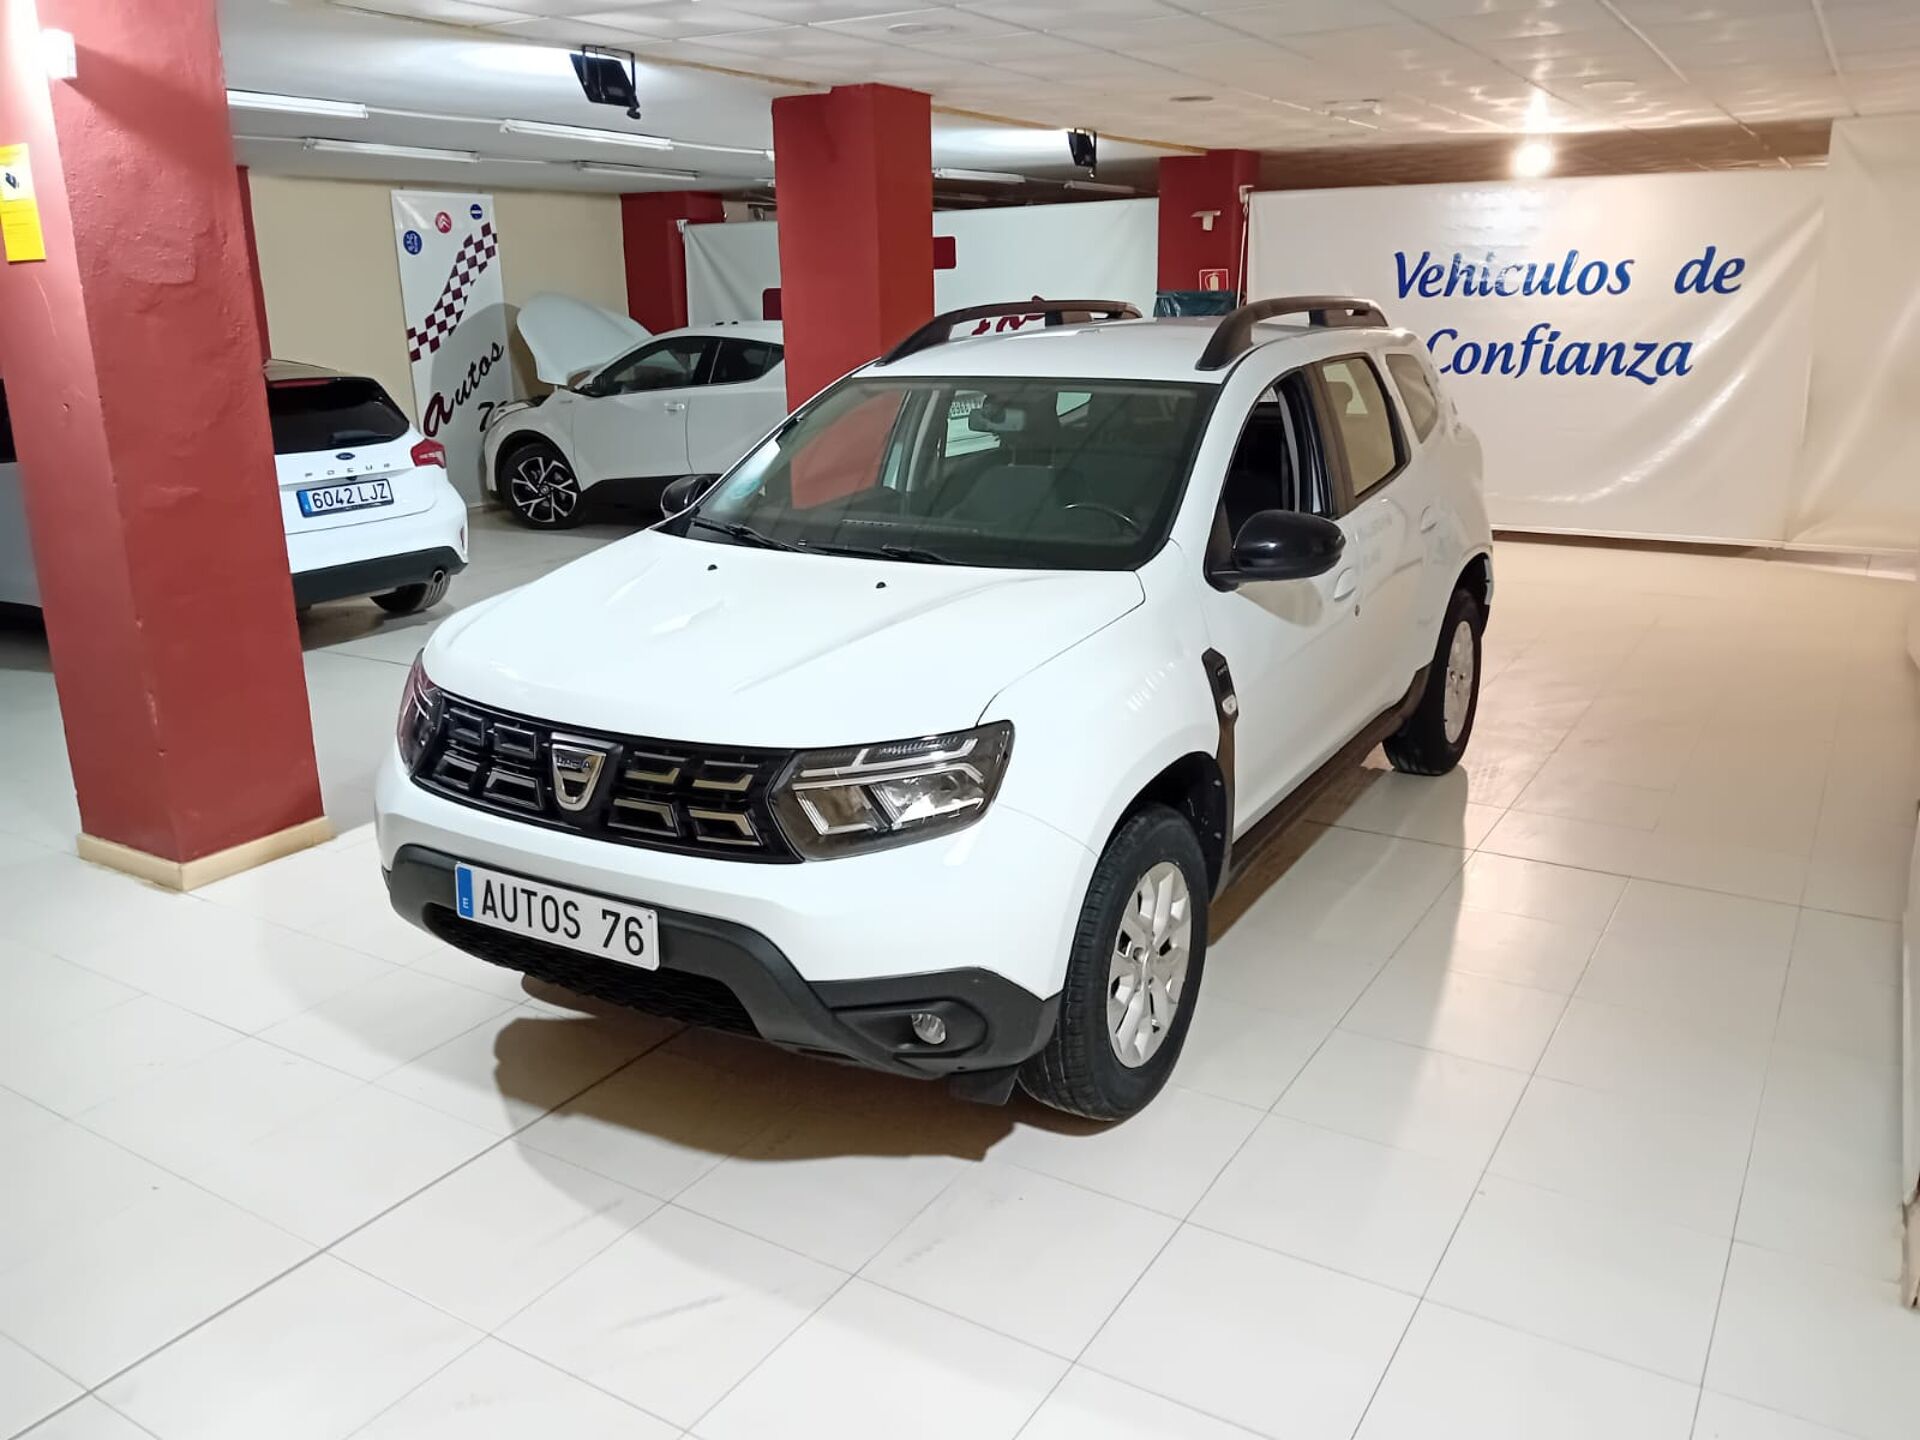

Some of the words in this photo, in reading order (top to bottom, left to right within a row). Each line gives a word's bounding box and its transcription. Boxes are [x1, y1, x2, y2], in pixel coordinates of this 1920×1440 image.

[1674, 245, 1746, 295] de
[1426, 322, 1694, 385] Confianza
[312, 488, 355, 509] 6042
[358, 482, 389, 502] LJZ
[481, 879, 581, 940] AUTOS
[601, 908, 645, 956] 76
